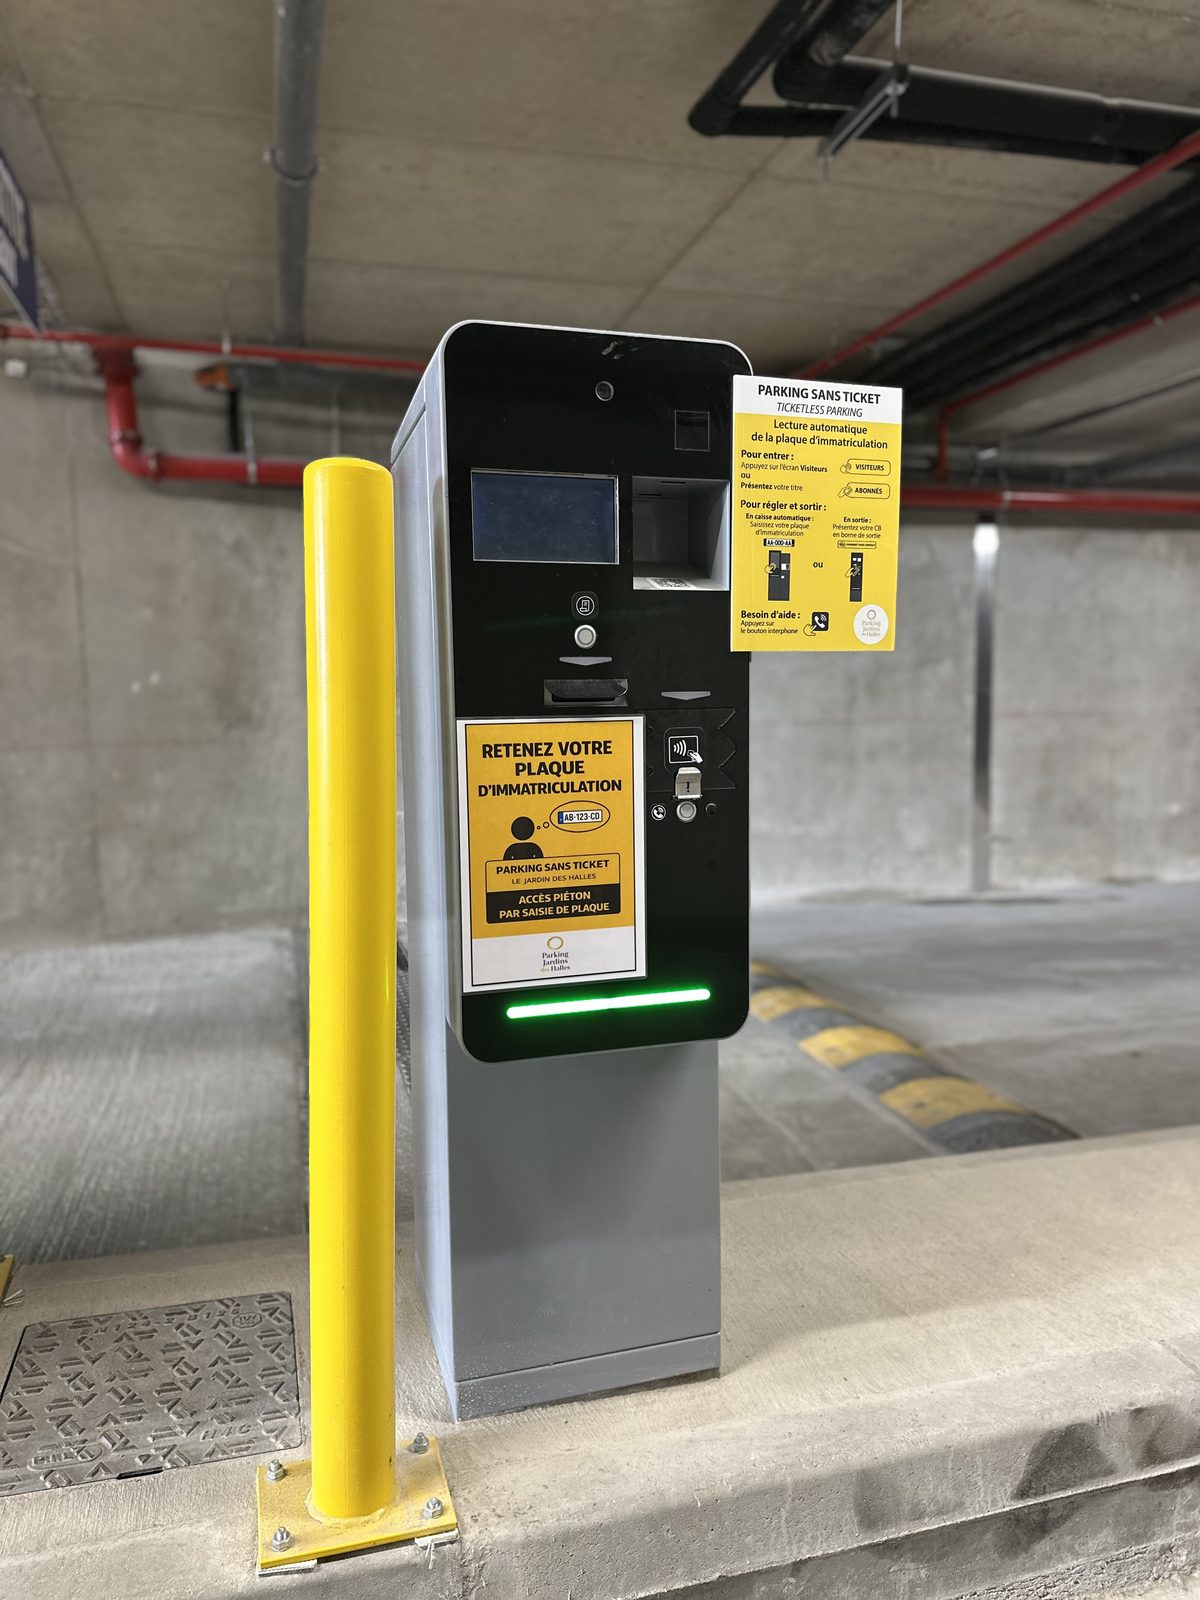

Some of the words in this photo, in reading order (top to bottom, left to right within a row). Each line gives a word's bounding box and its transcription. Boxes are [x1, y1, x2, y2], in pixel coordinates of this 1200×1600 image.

[758, 384, 809, 399] PARKING
[811, 390, 841, 401] SANS
[843, 392, 880, 404] TICKET
[777, 402, 825, 415] TICKETLESS
[826, 406, 862, 417] PARKING
[774, 419, 807, 430] Lecture
[810, 423, 867, 434] automatique
[751, 432, 763, 442] de
[765, 433, 773, 442] la
[776, 434, 807, 445] plaque
[809, 435, 888, 449] d’immatriculation
[741, 450, 761, 459] Pour
[763, 452, 789, 460] entrer
[741, 462, 767, 471] Appuyez
[741, 482, 772, 490] Présentez
[855, 486, 882, 494] ABONNÉS
[741, 500, 760, 509] Pour
[762, 501, 787, 511] régler
[789, 502, 797, 510] et
[800, 502, 822, 511] sortir
[773, 514, 811, 522] automatique
[482, 742, 553, 758] RETENEZ
[558, 740, 612, 755] VOTRE
[515, 760, 585, 777] PLAQUE
[478, 780, 622, 797] D’IMMATRICULATION
[564, 812, 600, 822] AB-123-CD
[496, 864, 542, 874] PARKING
[545, 862, 571, 871] SANS
[573, 859, 609, 869] TICKET
[523, 876, 550, 884] JARDIN
[519, 893, 551, 905] ACCÈS
[554, 890, 591, 901] PIÉTON
[499, 910, 520, 919] PAR
[522, 908, 553, 917] SAISIE
[556, 906, 568, 914] DE
[571, 903, 610, 913] PLAQUE
